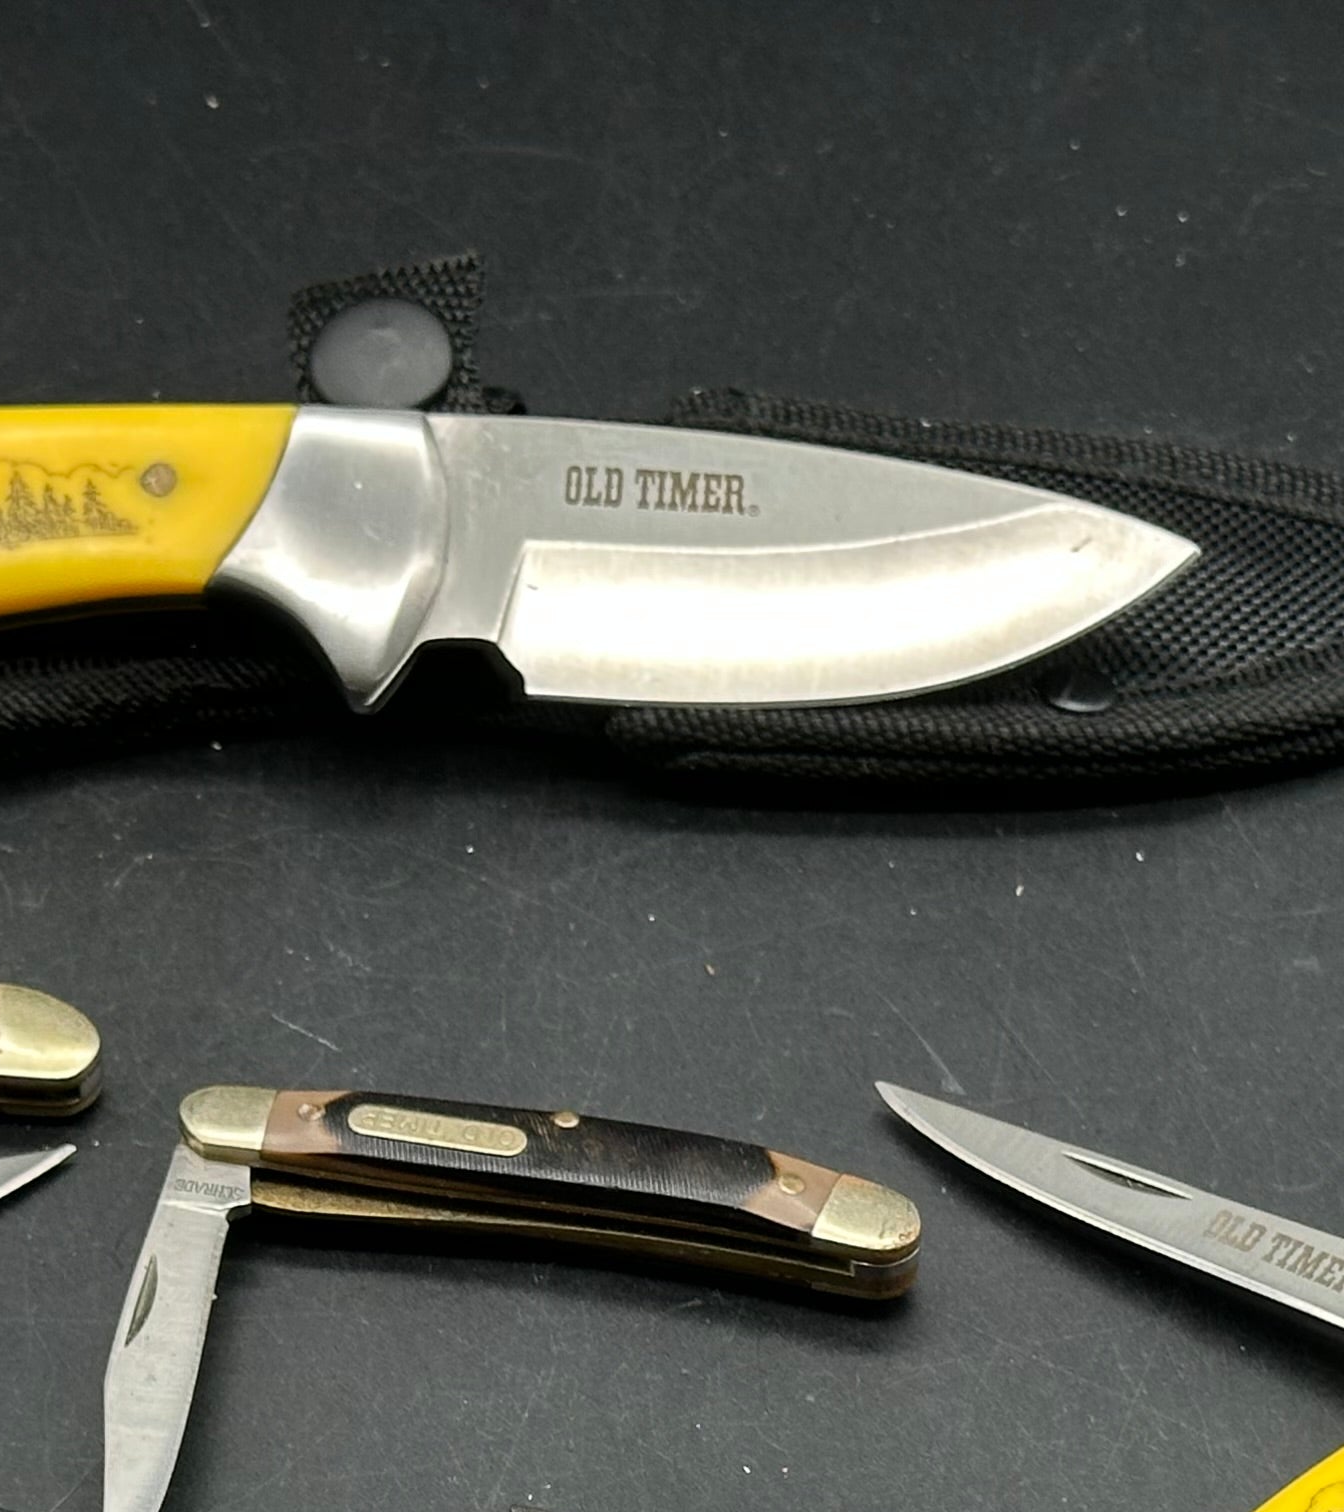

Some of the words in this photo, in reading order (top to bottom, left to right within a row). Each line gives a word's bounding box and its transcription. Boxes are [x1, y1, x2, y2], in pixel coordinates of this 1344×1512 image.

[564, 465, 624, 508] OLD
[634, 468, 745, 515] TIMER
[174, 1178, 245, 1201] SCHRADE
[1204, 1209, 1267, 1252] OLD
